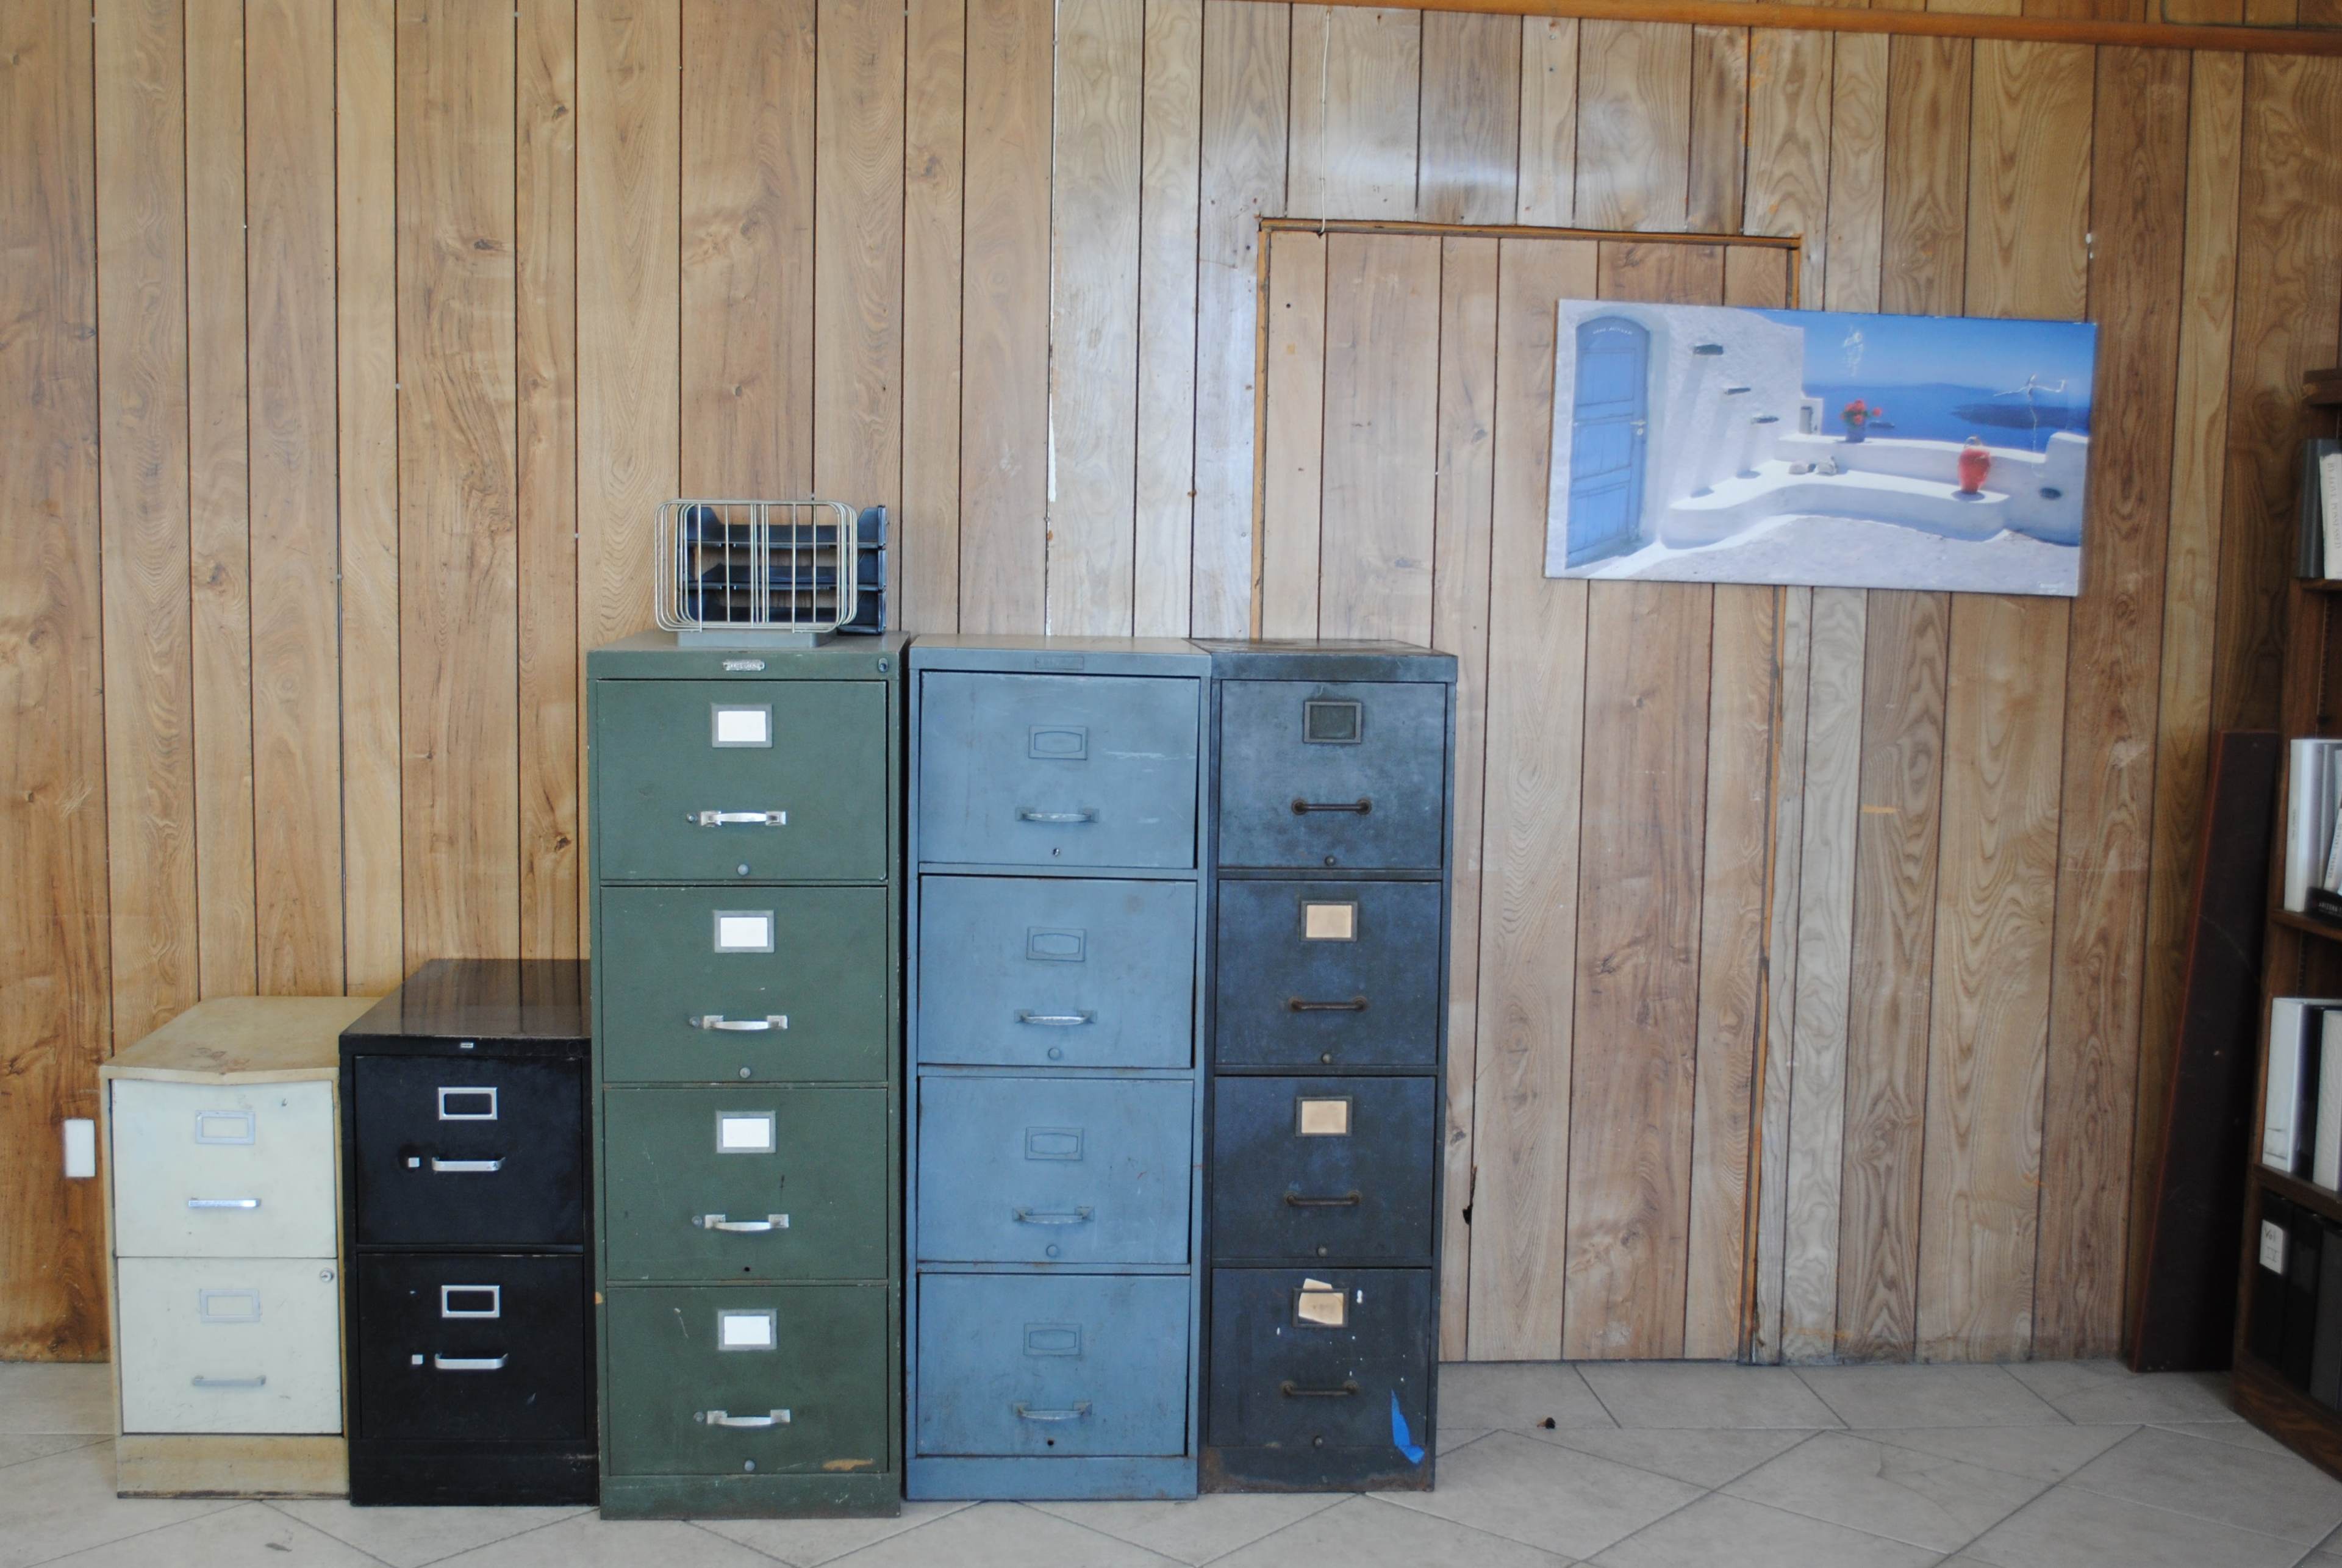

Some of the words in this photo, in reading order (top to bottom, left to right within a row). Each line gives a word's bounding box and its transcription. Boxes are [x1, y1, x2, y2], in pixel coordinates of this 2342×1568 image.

[2327, 463, 2335, 472] BY
[2329, 476, 2337, 498] LOVE
[2332, 503, 2341, 549] POSSESSED
[2327, 853, 2337, 879] GENERAL
